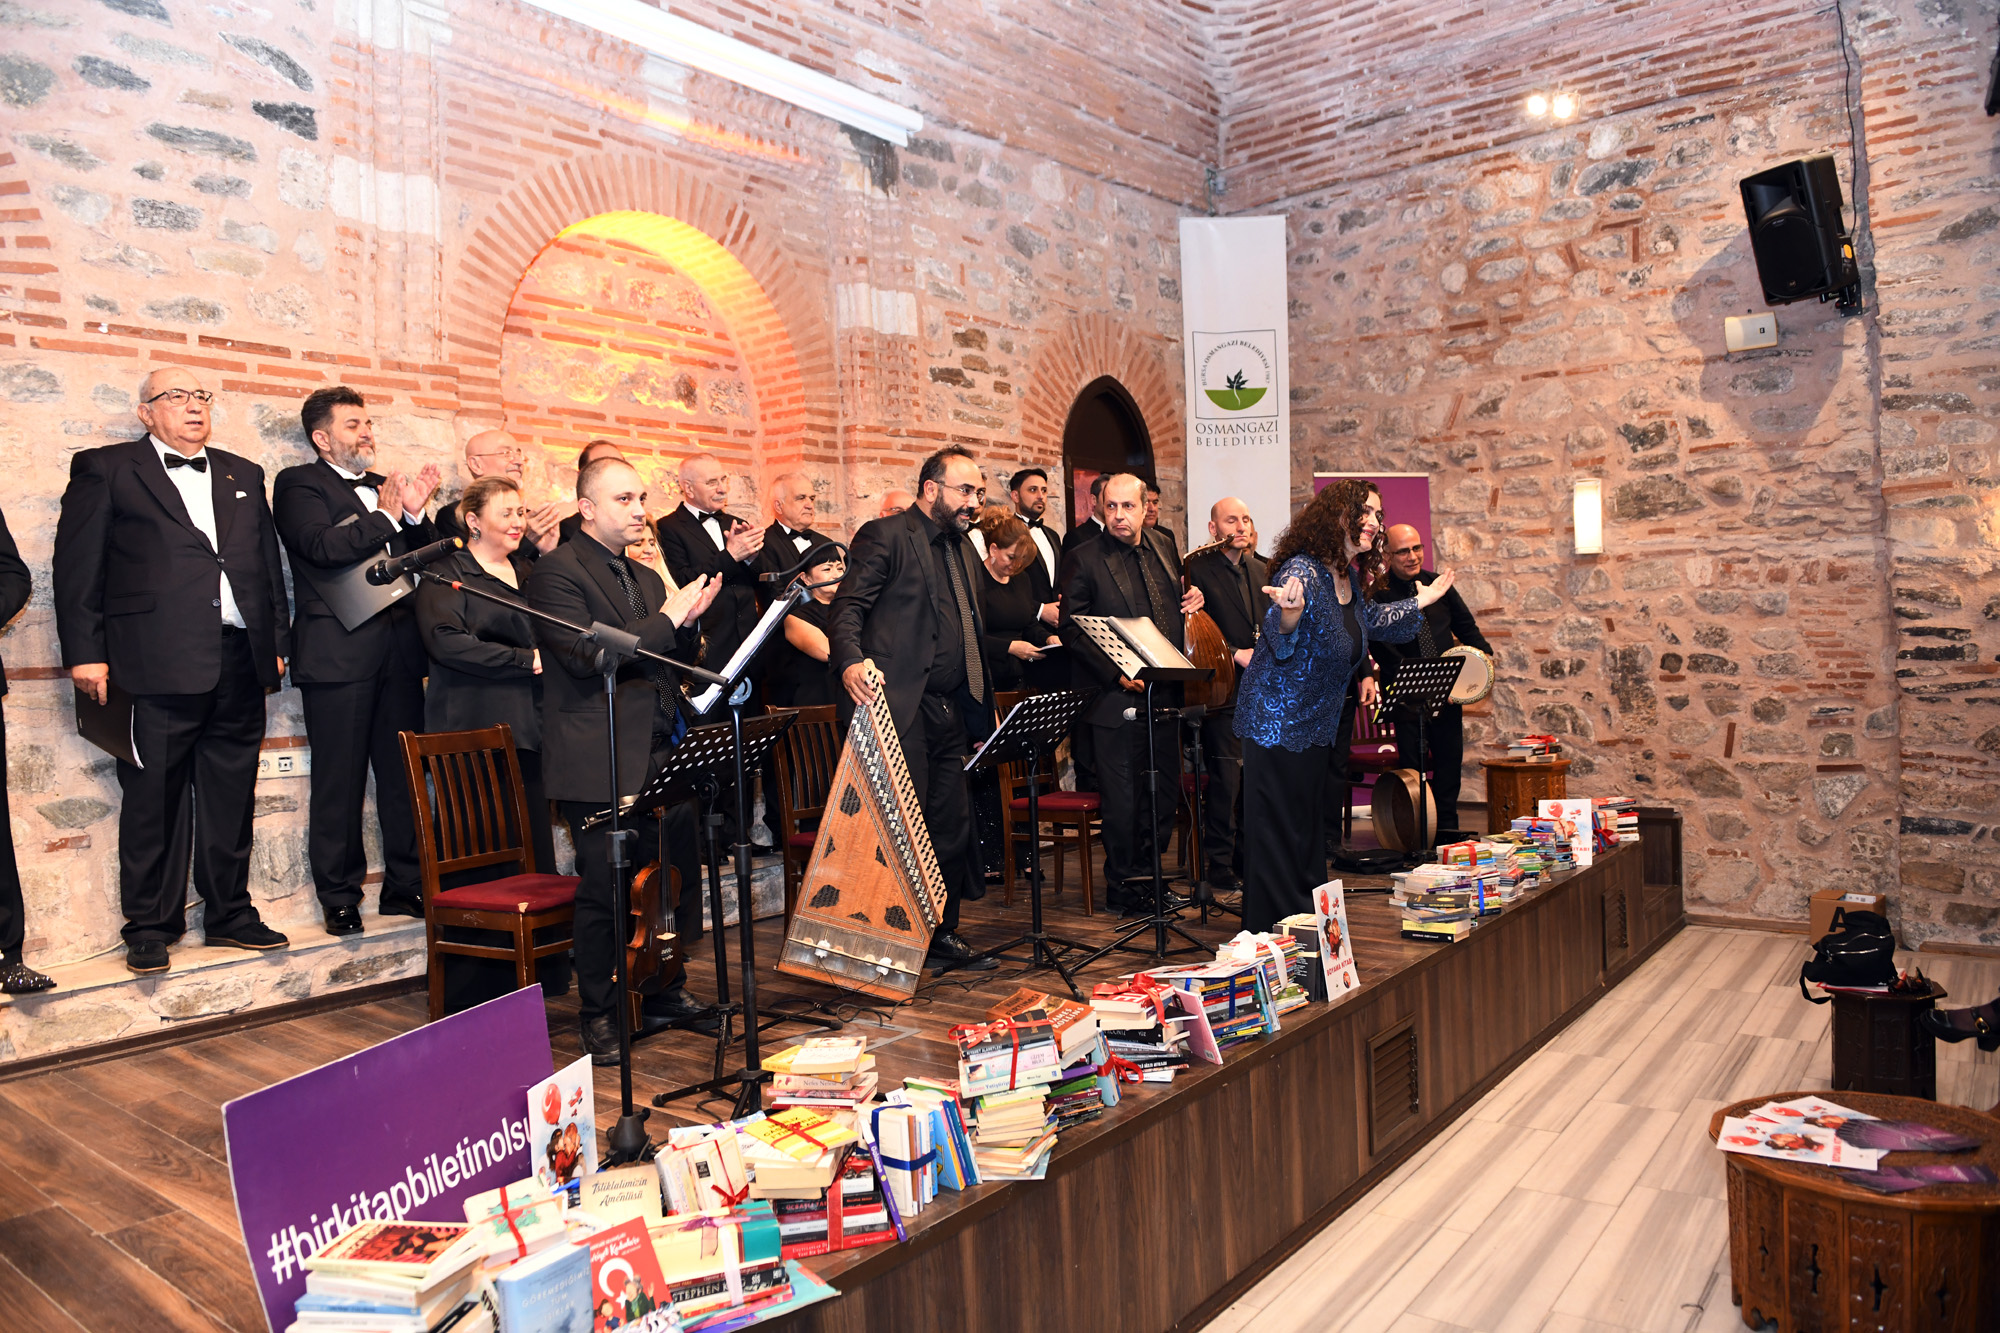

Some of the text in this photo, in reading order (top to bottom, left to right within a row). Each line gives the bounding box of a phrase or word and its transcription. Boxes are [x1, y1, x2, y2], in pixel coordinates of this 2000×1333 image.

[1204, 339, 1238, 363] OSMANGAZİ
[1239, 340, 1270, 369] BELEDİYESİ
[1195, 419, 1279, 435] OSMANGAZİ
[1196, 435, 1279, 447] BELEDİYESİ
[1048, 1008, 1073, 1023] JAMES
[1052, 1006, 1085, 1029] ROLLINS
[671, 1282, 720, 1304] STEPHEN
